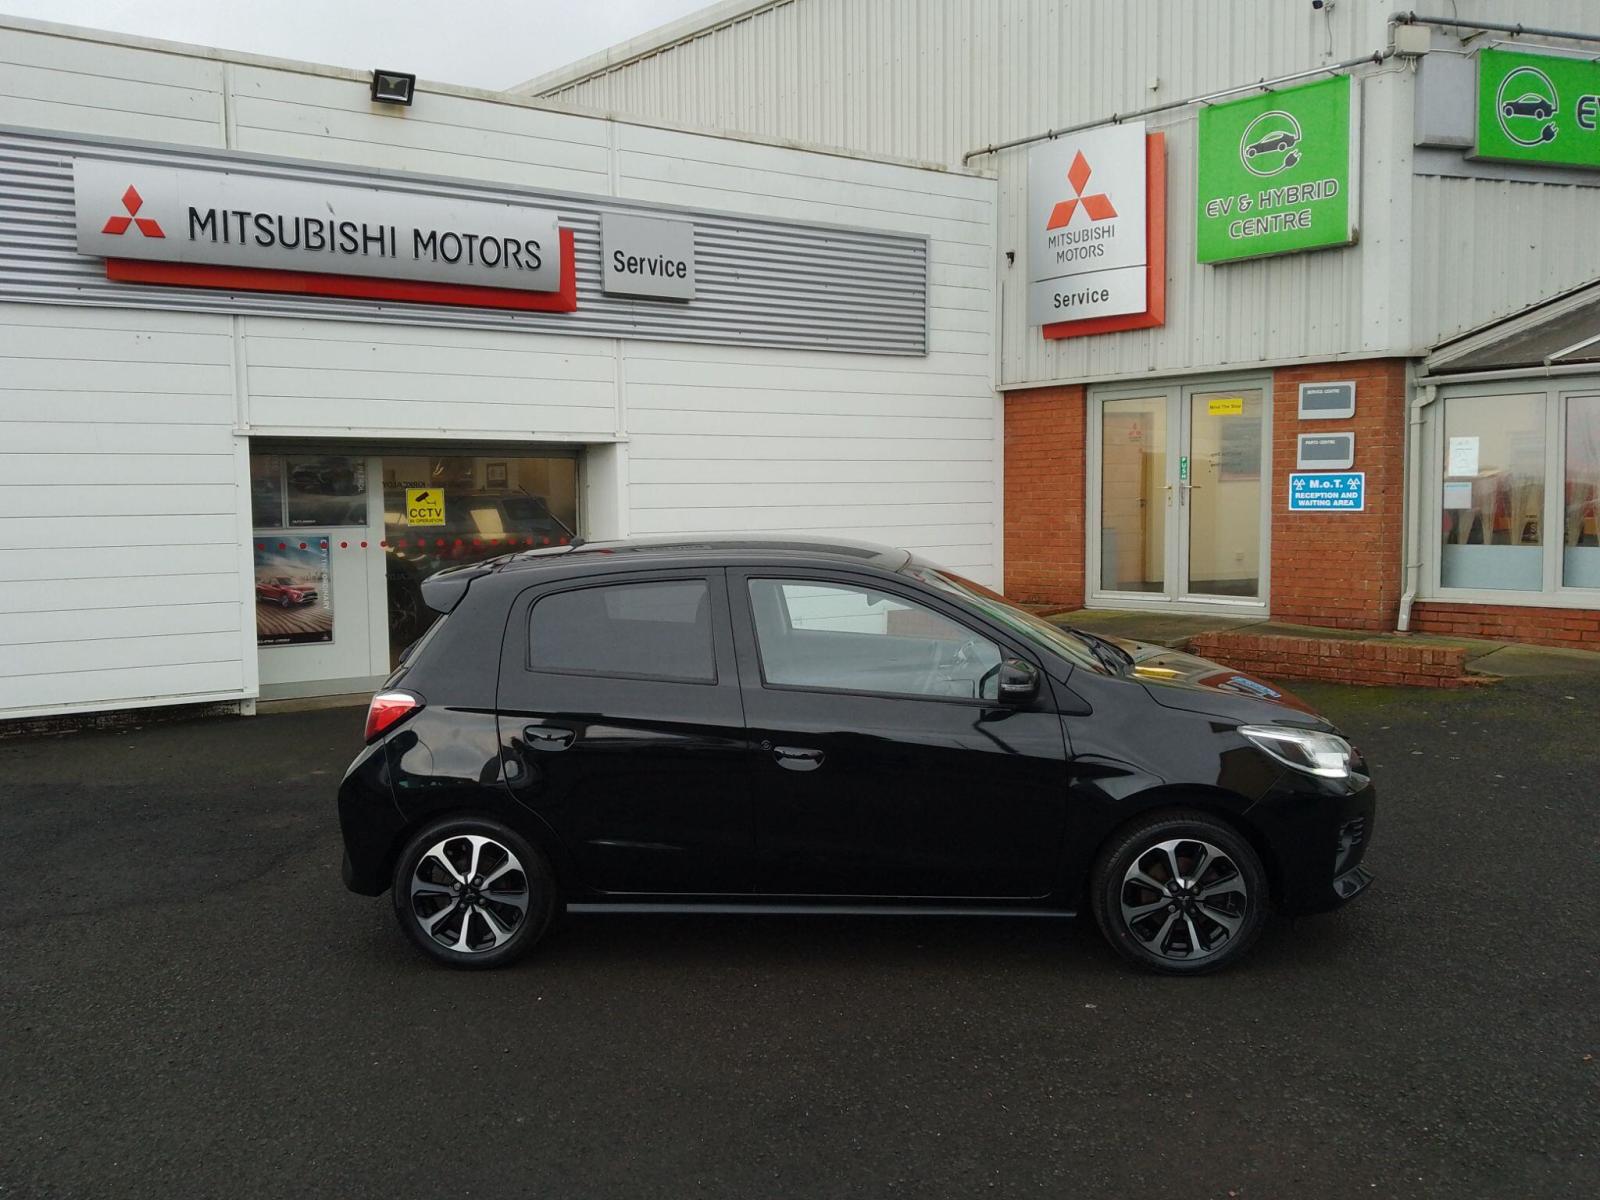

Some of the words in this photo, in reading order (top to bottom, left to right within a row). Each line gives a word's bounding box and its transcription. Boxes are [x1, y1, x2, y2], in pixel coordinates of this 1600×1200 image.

[1576, 94, 1600, 130] E
[1206, 197, 1234, 218] EV
[1238, 194, 1252, 213] &
[1259, 178, 1339, 209] HYBRID
[188, 206, 395, 257] MITSUBISHI
[413, 228, 542, 270] MOTORS
[1048, 224, 1115, 249] MITSUBISHI
[1229, 208, 1312, 239] CENTRE
[613, 250, 687, 279] Service
[1056, 243, 1105, 264] MOTORS
[1053, 288, 1110, 309] Service
[410, 508, 442, 518] CCTV
